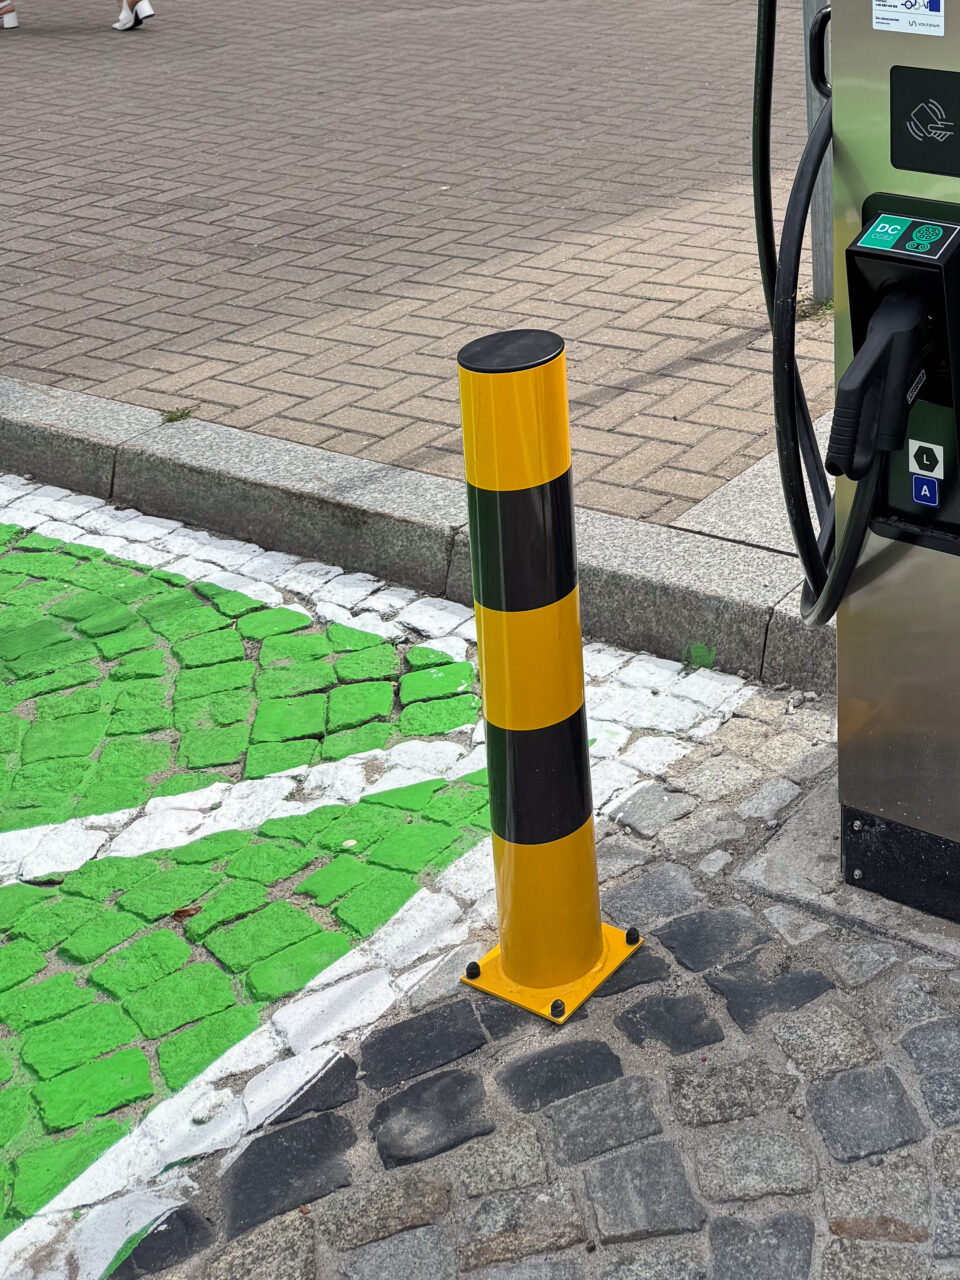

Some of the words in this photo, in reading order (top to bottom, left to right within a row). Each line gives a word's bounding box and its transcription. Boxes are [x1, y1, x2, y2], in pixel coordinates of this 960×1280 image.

[875, 223, 900, 234] DC
[871, 233, 893, 241] CCS2
[923, 454, 930, 464] L
[920, 484, 931, 497] A
